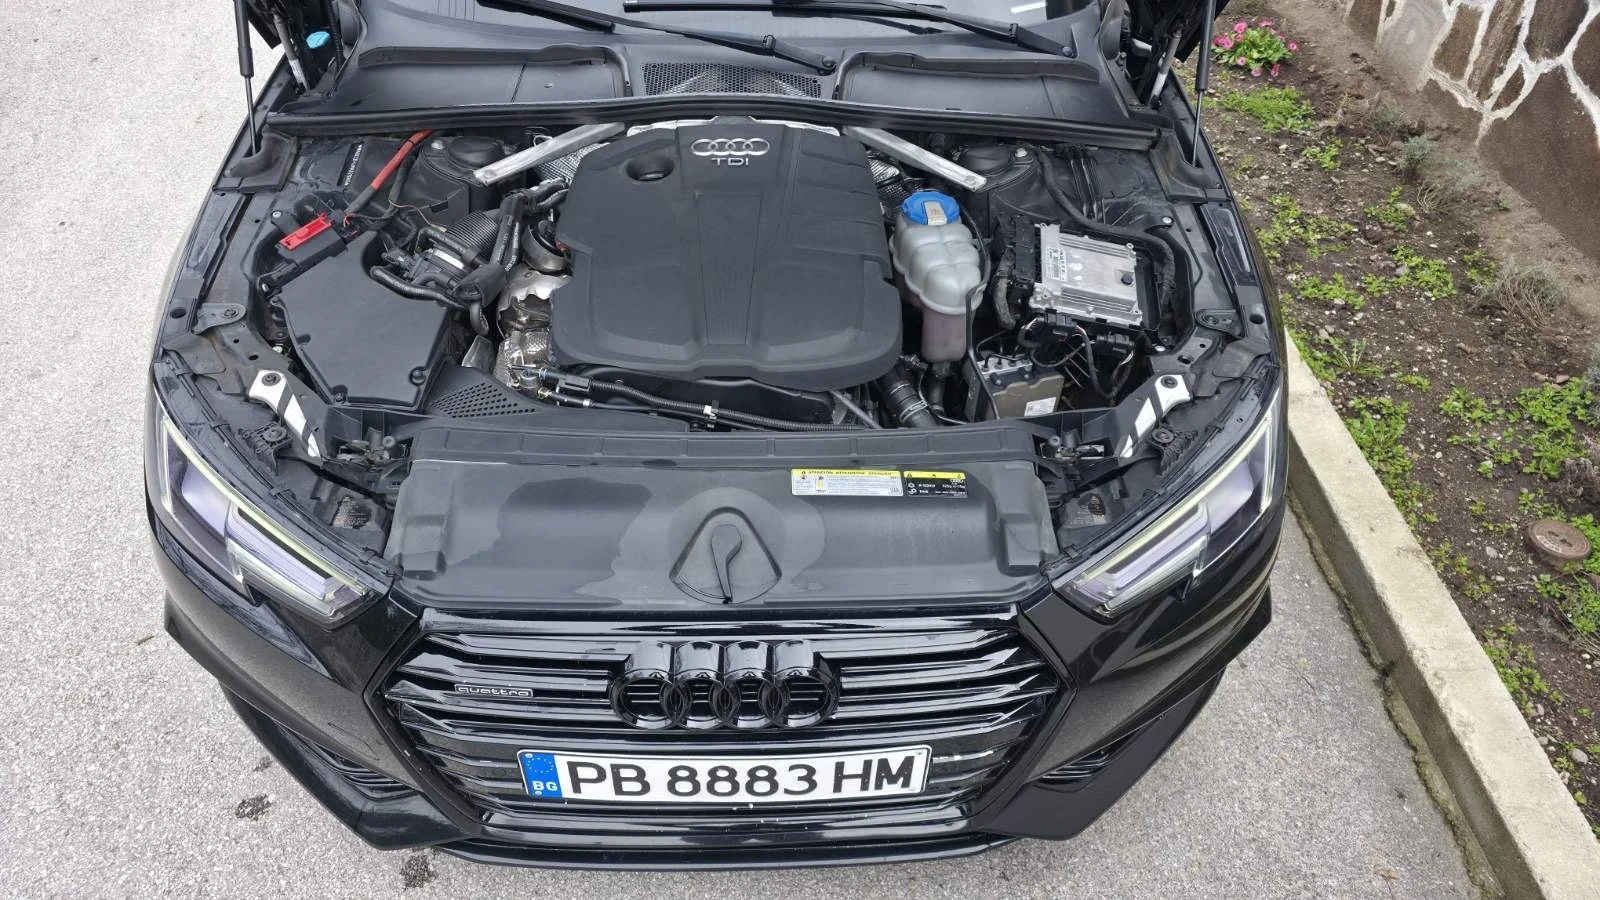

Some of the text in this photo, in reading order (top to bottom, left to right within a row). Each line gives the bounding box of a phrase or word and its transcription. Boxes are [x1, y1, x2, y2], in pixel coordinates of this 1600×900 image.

[711, 157, 749, 166] TDI
[458, 687, 529, 696] quattro
[566, 755, 915, 797] PB 8883 HM
[532, 780, 558, 791] BG
